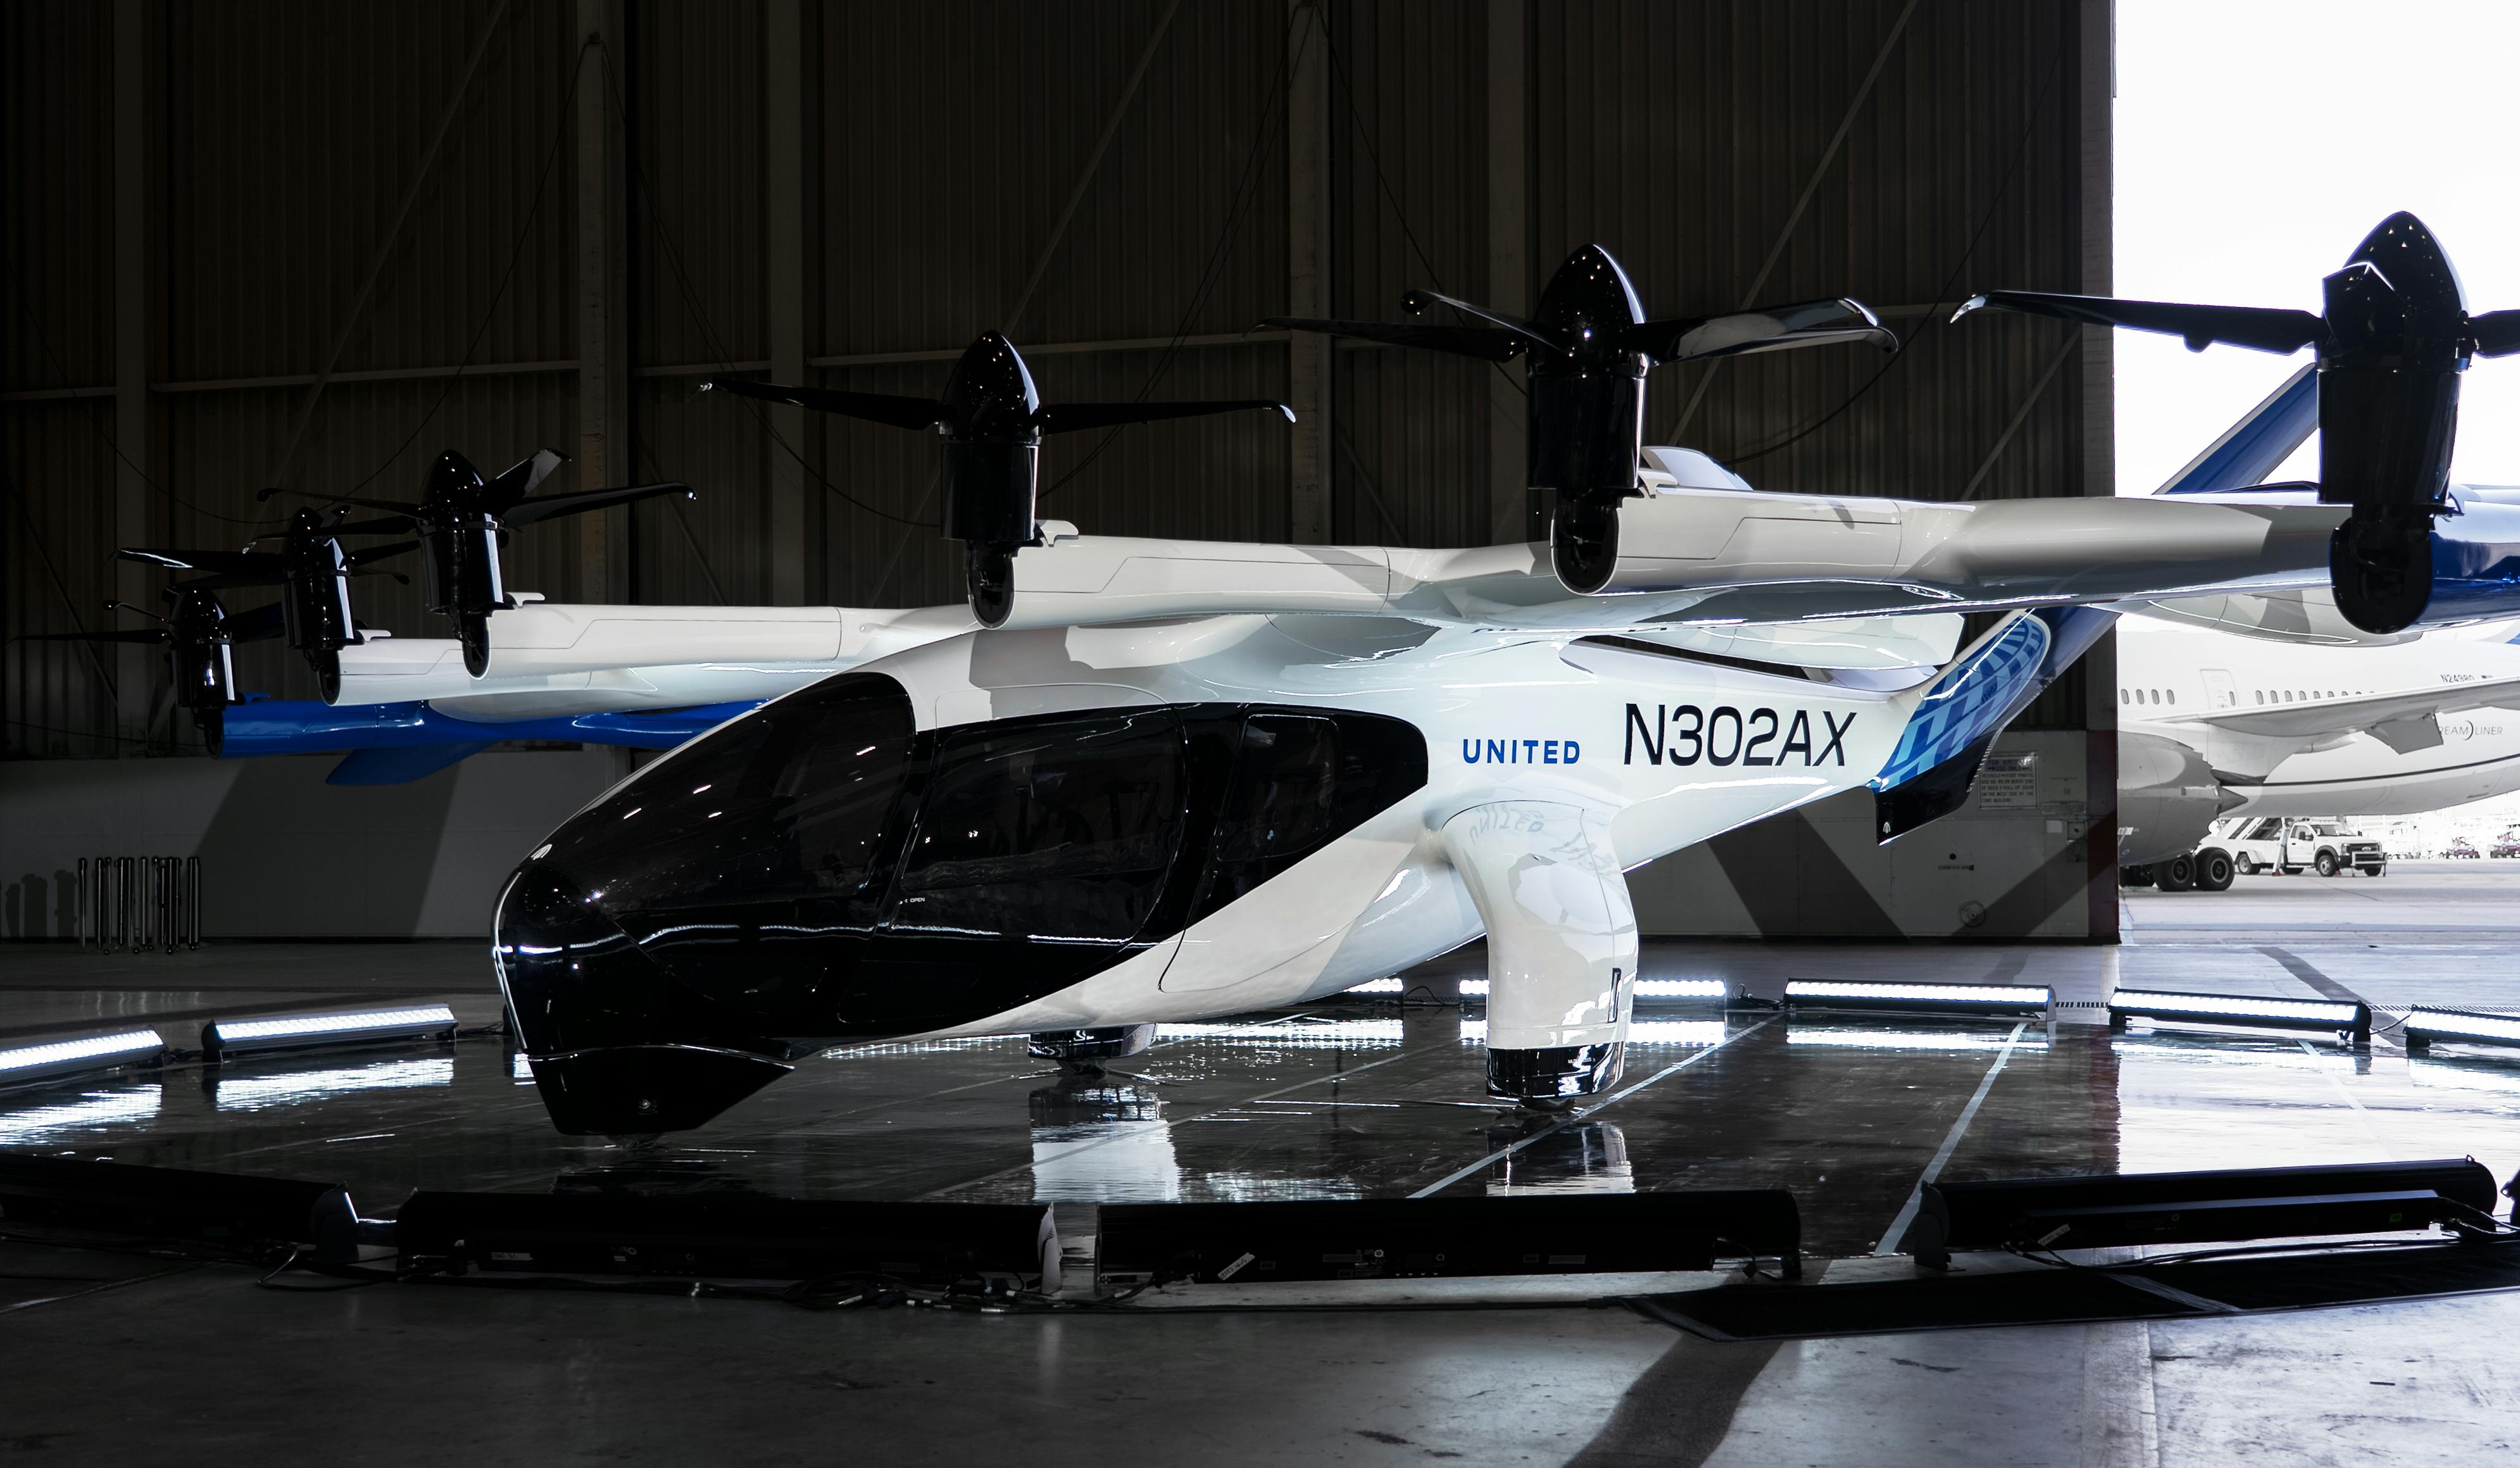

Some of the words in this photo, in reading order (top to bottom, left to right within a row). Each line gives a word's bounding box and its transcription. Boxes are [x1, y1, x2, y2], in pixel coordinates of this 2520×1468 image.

[1624, 703, 1857, 767] N302AX
[2438, 725, 2504, 736] REAMLINER
[1463, 739, 1580, 764] UNITED
